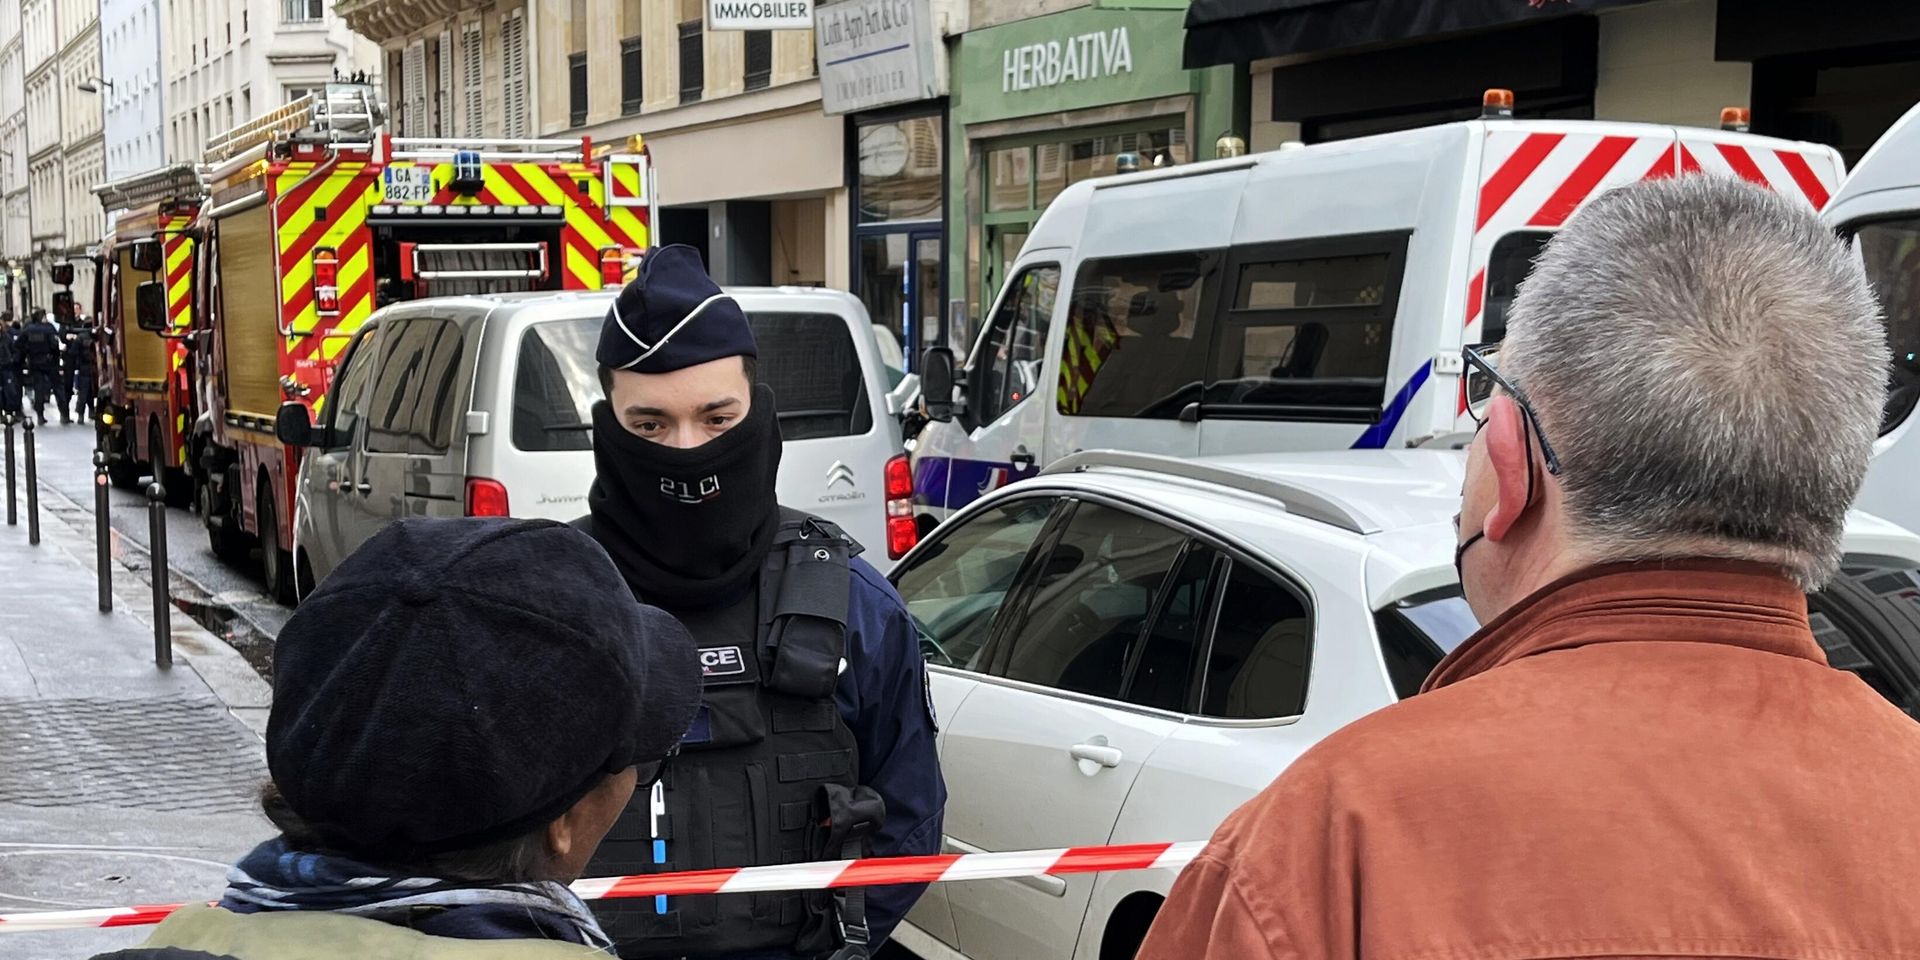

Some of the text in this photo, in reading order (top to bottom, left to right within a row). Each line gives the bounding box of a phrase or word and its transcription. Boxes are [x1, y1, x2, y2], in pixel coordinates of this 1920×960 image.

[715, 3, 808, 19] IMMOBILIER
[881, 0, 892, 31] &
[1003, 26, 1133, 93] HERBATIVA
[836, 70, 906, 102] IMMOBILIER
[660, 474, 720, 499] 21 CI
[700, 649, 738, 666] CE
